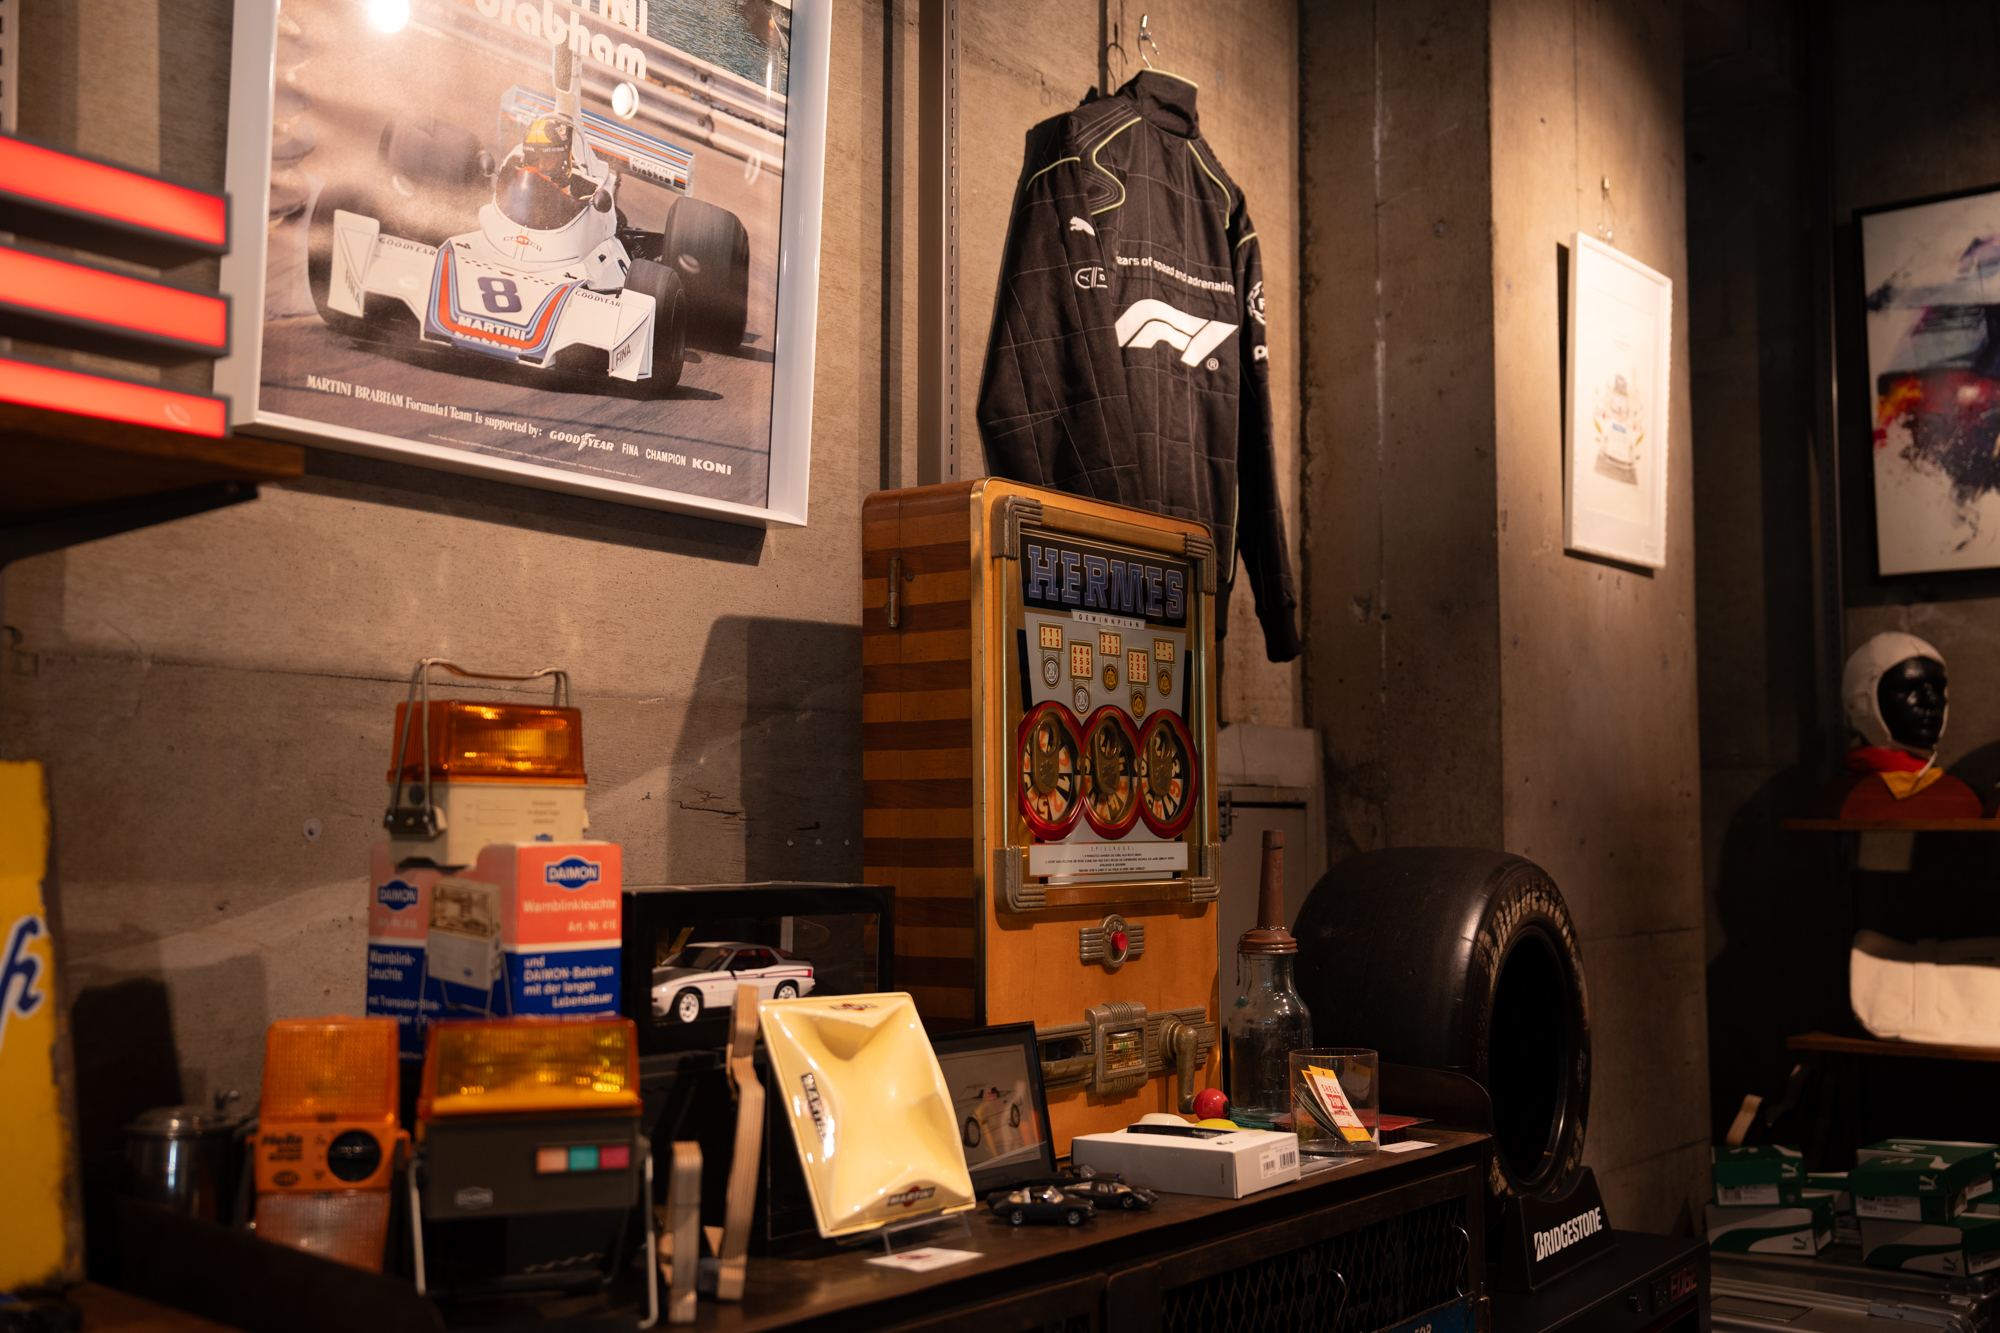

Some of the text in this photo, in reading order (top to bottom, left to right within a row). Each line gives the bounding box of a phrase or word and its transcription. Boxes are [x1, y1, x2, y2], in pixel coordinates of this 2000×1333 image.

[379, 237, 436, 256] GOODYEAR
[1116, 256, 1140, 266] ears
[1141, 256, 1153, 267] of
[1187, 276, 1235, 295] adrenalin
[477, 276, 522, 313] 8
[575, 290, 621, 307] GOODYEAR
[457, 316, 526, 341] MARTINI
[615, 343, 631, 367] FINA
[306, 374, 352, 397] MARTINI
[355, 385, 403, 407] BRABHAM
[449, 405, 472, 422] Team
[475, 412, 483, 424] is
[485, 416, 527, 435] supported
[528, 424, 542, 438] by:
[621, 442, 639, 457] FINA
[645, 448, 687, 467] CHAMPION
[692, 457, 733, 476] KONI
[1027, 544, 1184, 620] HERMES
[1078, 613, 1140, 628] GEWINNPLAN
[549, 866, 598, 881] DAIMON
[380, 887, 416, 903] DAIMON
[523, 898, 617, 913] Warnblinkleuchte
[370, 950, 416, 966] Warnblink-
[523, 955, 545, 969] und
[369, 966, 404, 982] Leuchte
[523, 964, 614, 982] DAIMON-Batterien
[523, 980, 596, 996] mit der langen
[552, 992, 613, 1009] Lebensdauer
[1321, 1084, 1340, 1094] SHELL
[1534, 1206, 1603, 1262] BRIDGESTONE
